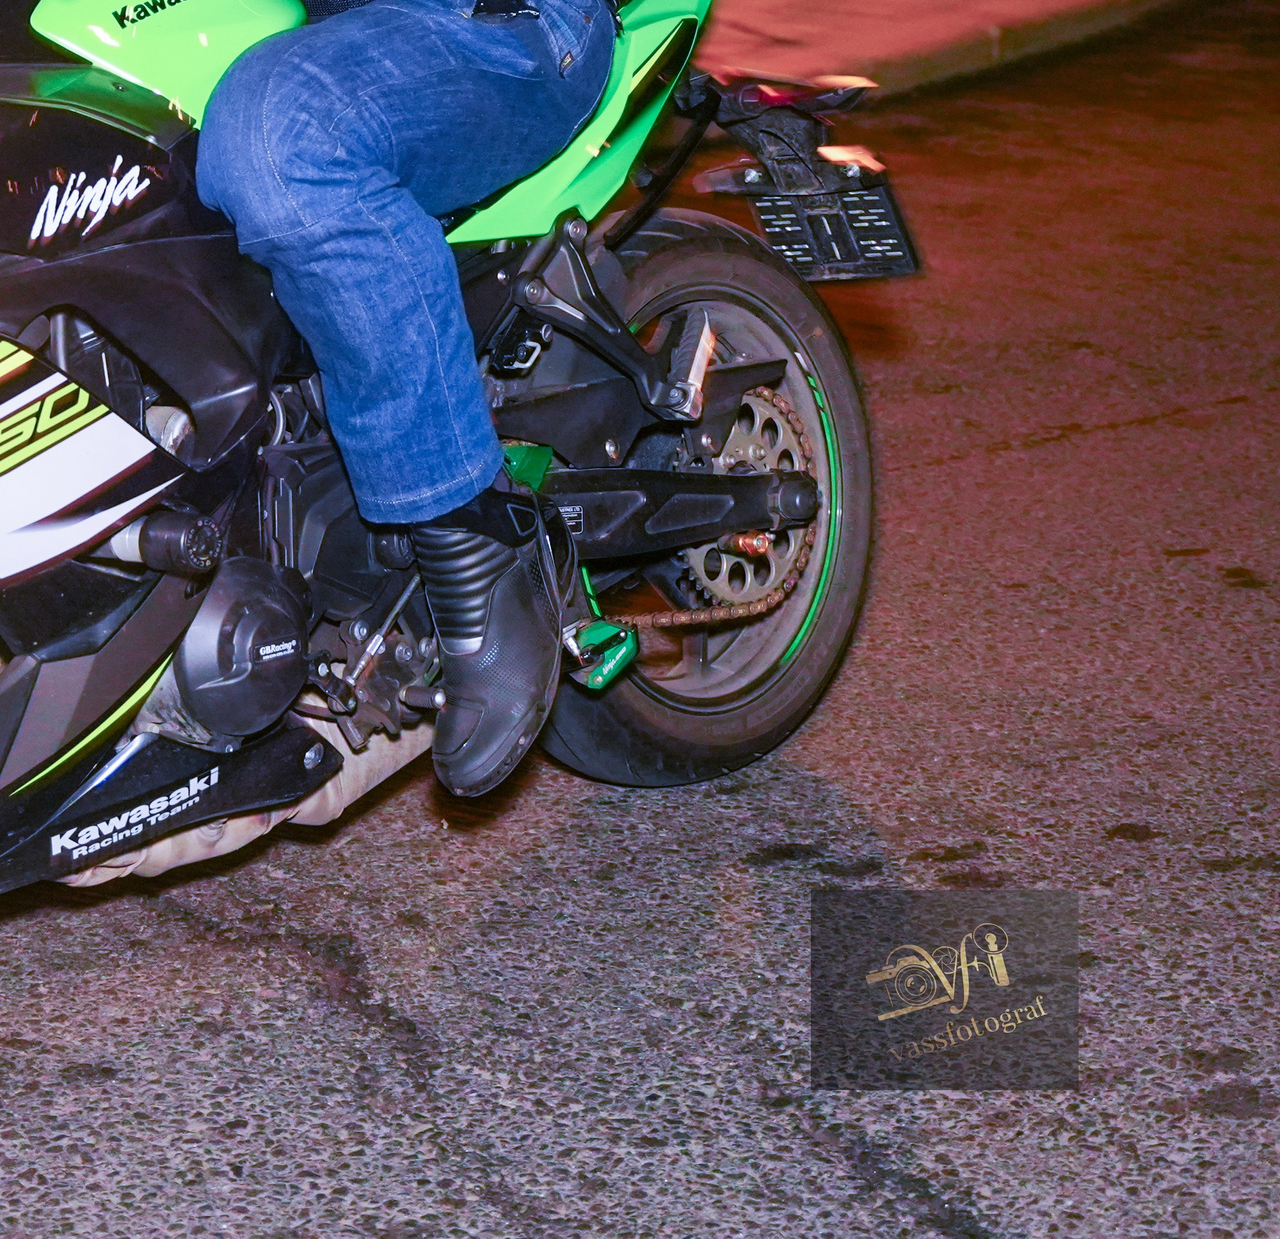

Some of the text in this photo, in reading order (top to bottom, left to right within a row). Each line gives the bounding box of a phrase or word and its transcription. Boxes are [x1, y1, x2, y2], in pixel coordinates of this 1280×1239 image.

[30, 154, 150, 240] Ninja
[51, 766, 219, 856] Kawasaki
[72, 796, 200, 860] Racing Team
